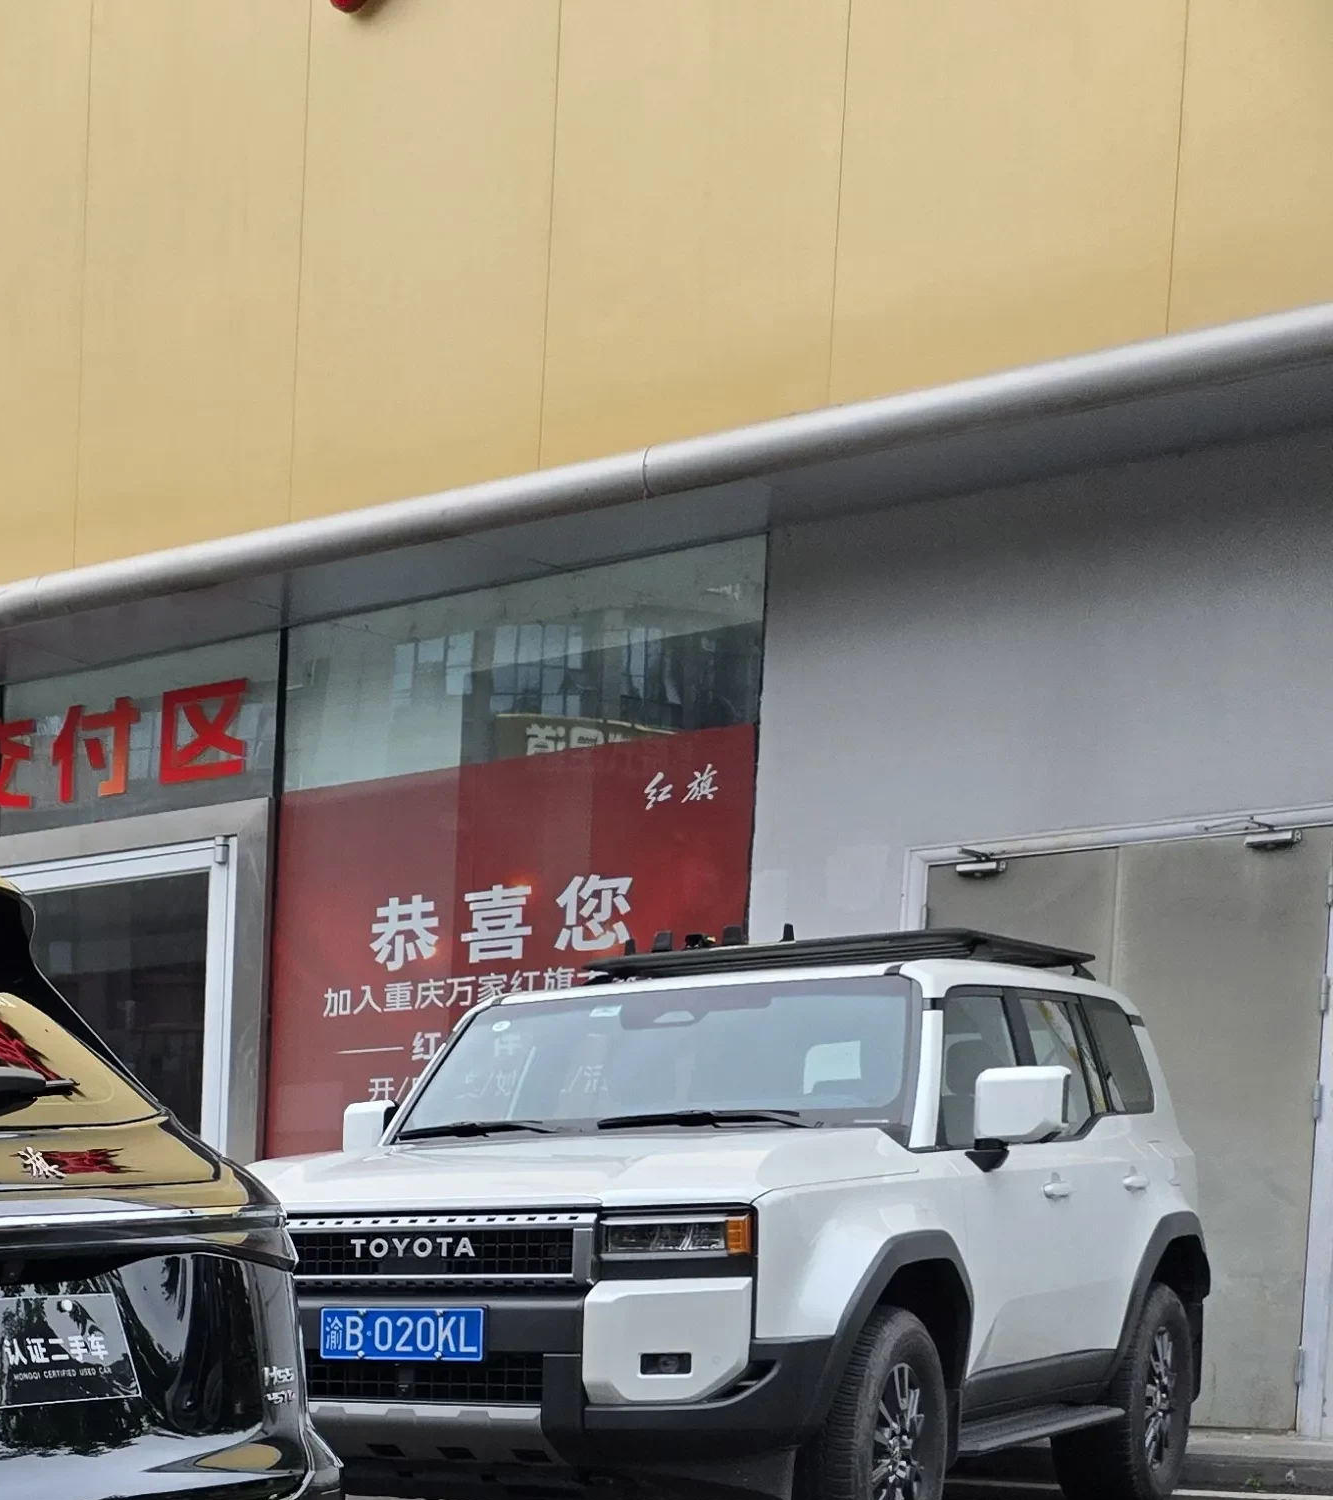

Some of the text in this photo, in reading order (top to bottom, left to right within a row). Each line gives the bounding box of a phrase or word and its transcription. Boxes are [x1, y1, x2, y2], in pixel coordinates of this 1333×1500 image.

[643, 763, 719, 811] 红旗
[369, 873, 633, 972] 恭喜您
[350, 1236, 476, 1258] TOYOTA
[3, 1333, 109, 1367] 认证二手车
[13, 1366, 113, 1381] HONGQI CERTIFIED USED CAR
